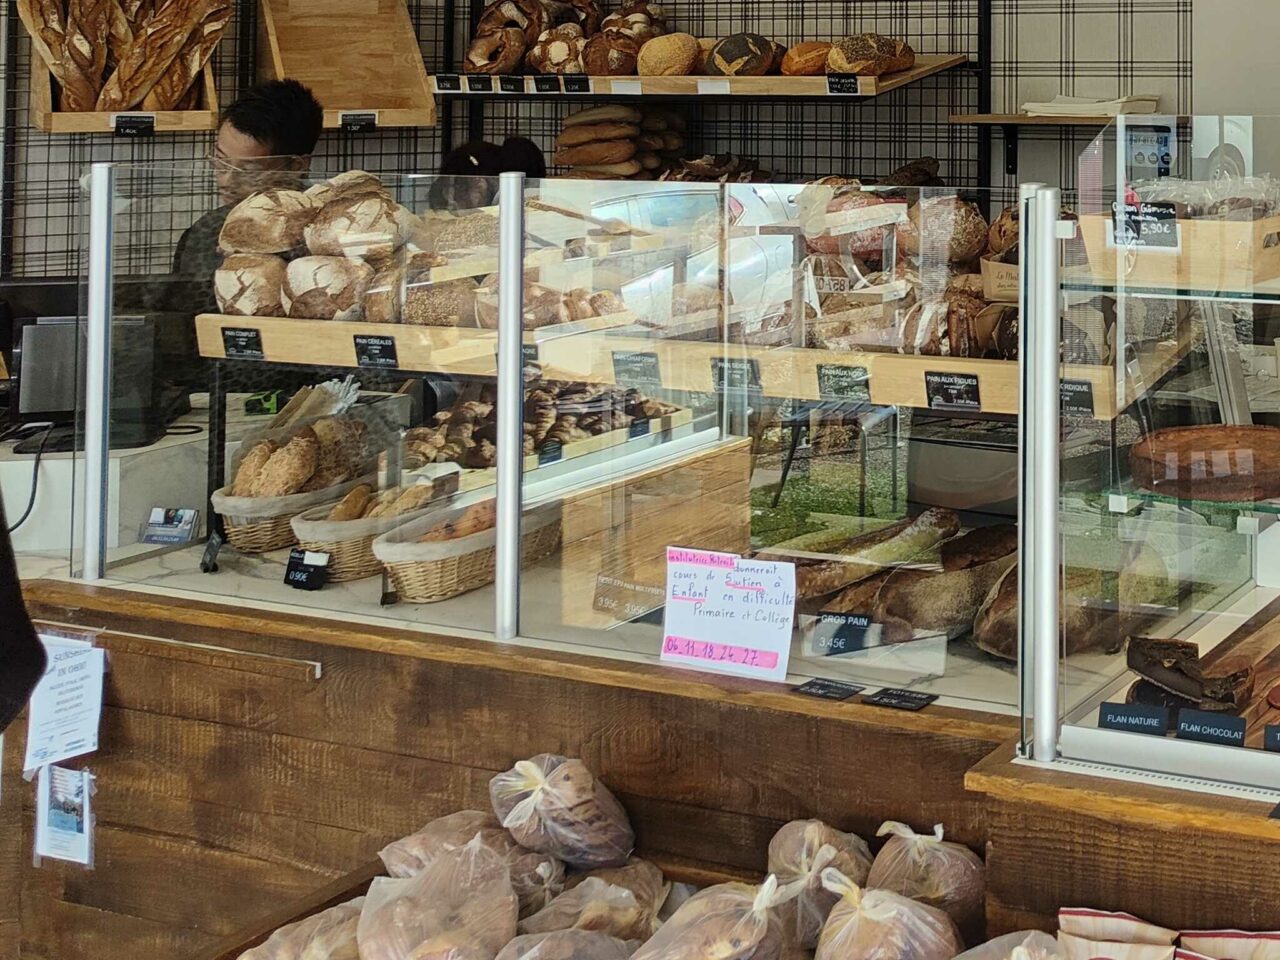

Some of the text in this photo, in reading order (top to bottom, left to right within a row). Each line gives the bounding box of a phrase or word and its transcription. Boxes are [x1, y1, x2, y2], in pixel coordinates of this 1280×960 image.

[927, 375, 940, 383] PAIN
[693, 602, 735, 618] Primaire
[821, 615, 868, 626] GROS PAIN
[1107, 714, 1160, 727] FLAN NATURE
[1180, 723, 1243, 739] FLAN CHOCOLAT
